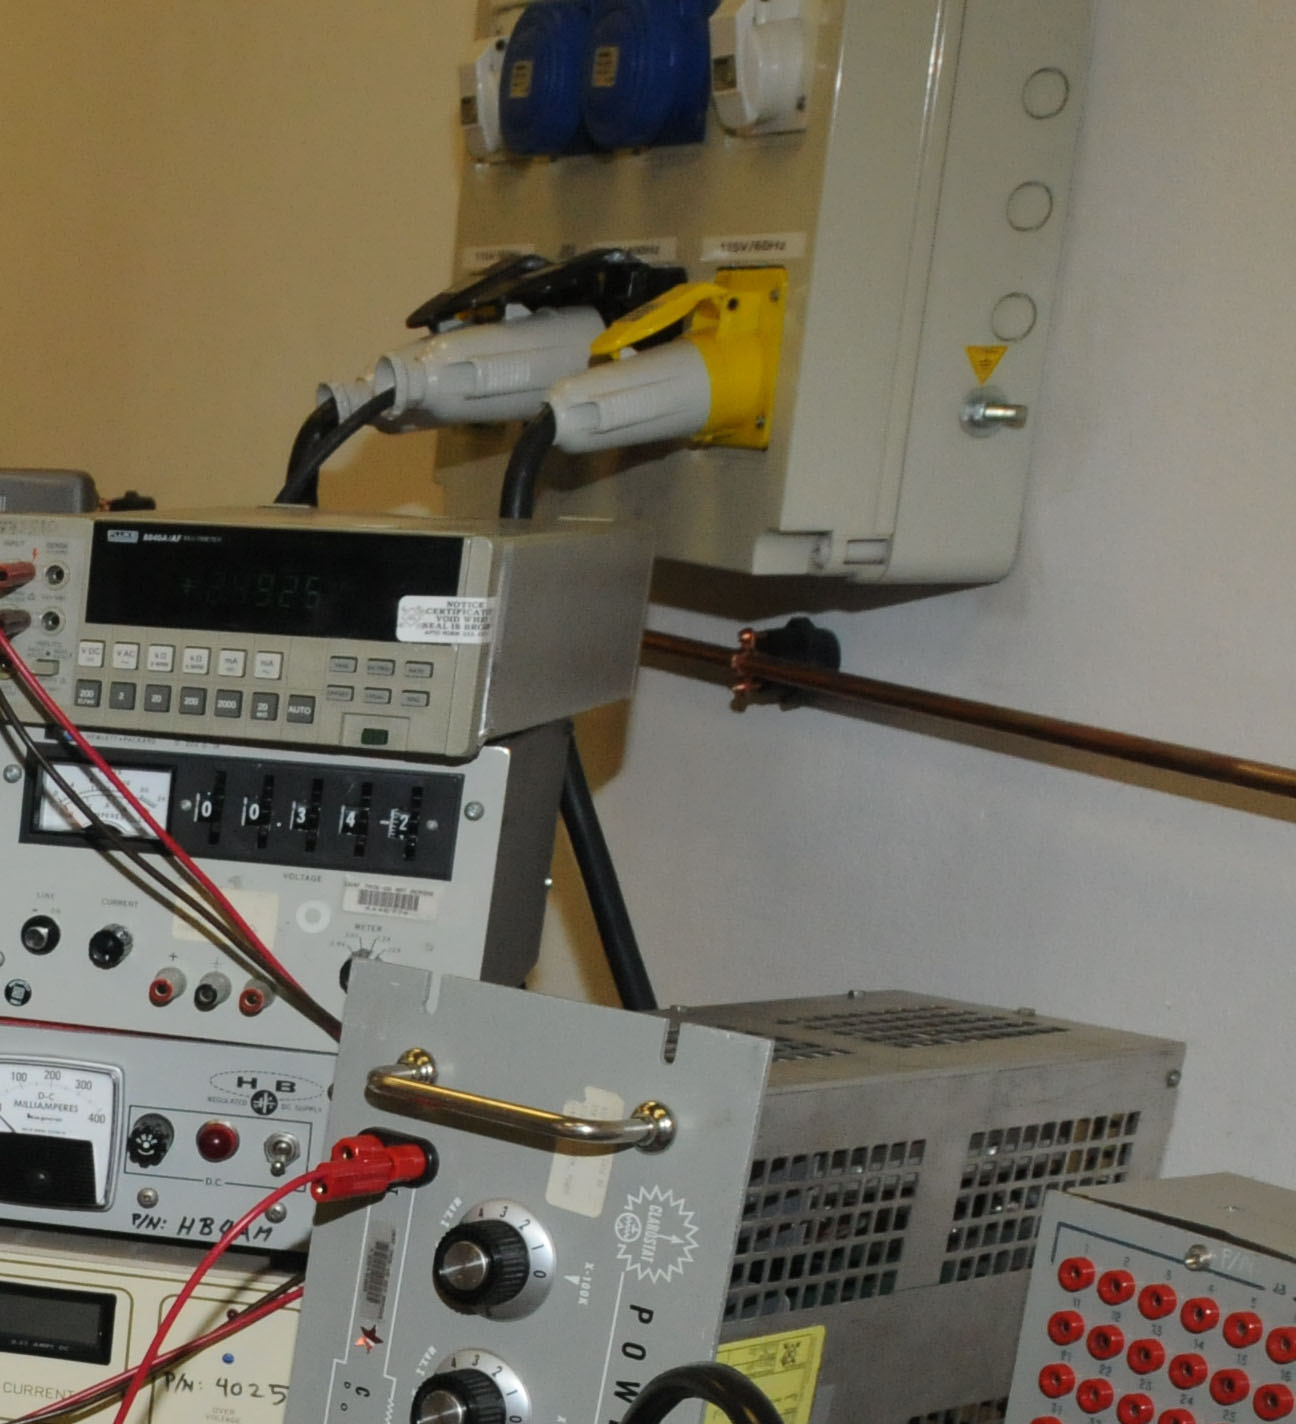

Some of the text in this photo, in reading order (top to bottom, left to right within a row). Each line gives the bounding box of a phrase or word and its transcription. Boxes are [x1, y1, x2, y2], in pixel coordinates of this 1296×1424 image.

[446, 600, 486, 609] NOTICE
[436, 614, 461, 623] VOID
[288, 703, 313, 715] AUTO
[296, 807, 306, 824] 3
[283, 872, 322, 883] VOLTAGE
[11, 1071, 28, 1082] 100
[44, 1070, 61, 1081] 200
[74, 1079, 93, 1091] 300
[12, 1099, 80, 1114] MILLIAMPERES
[88, 1113, 107, 1124] 400
[214, 1376, 291, 1407] 4025
